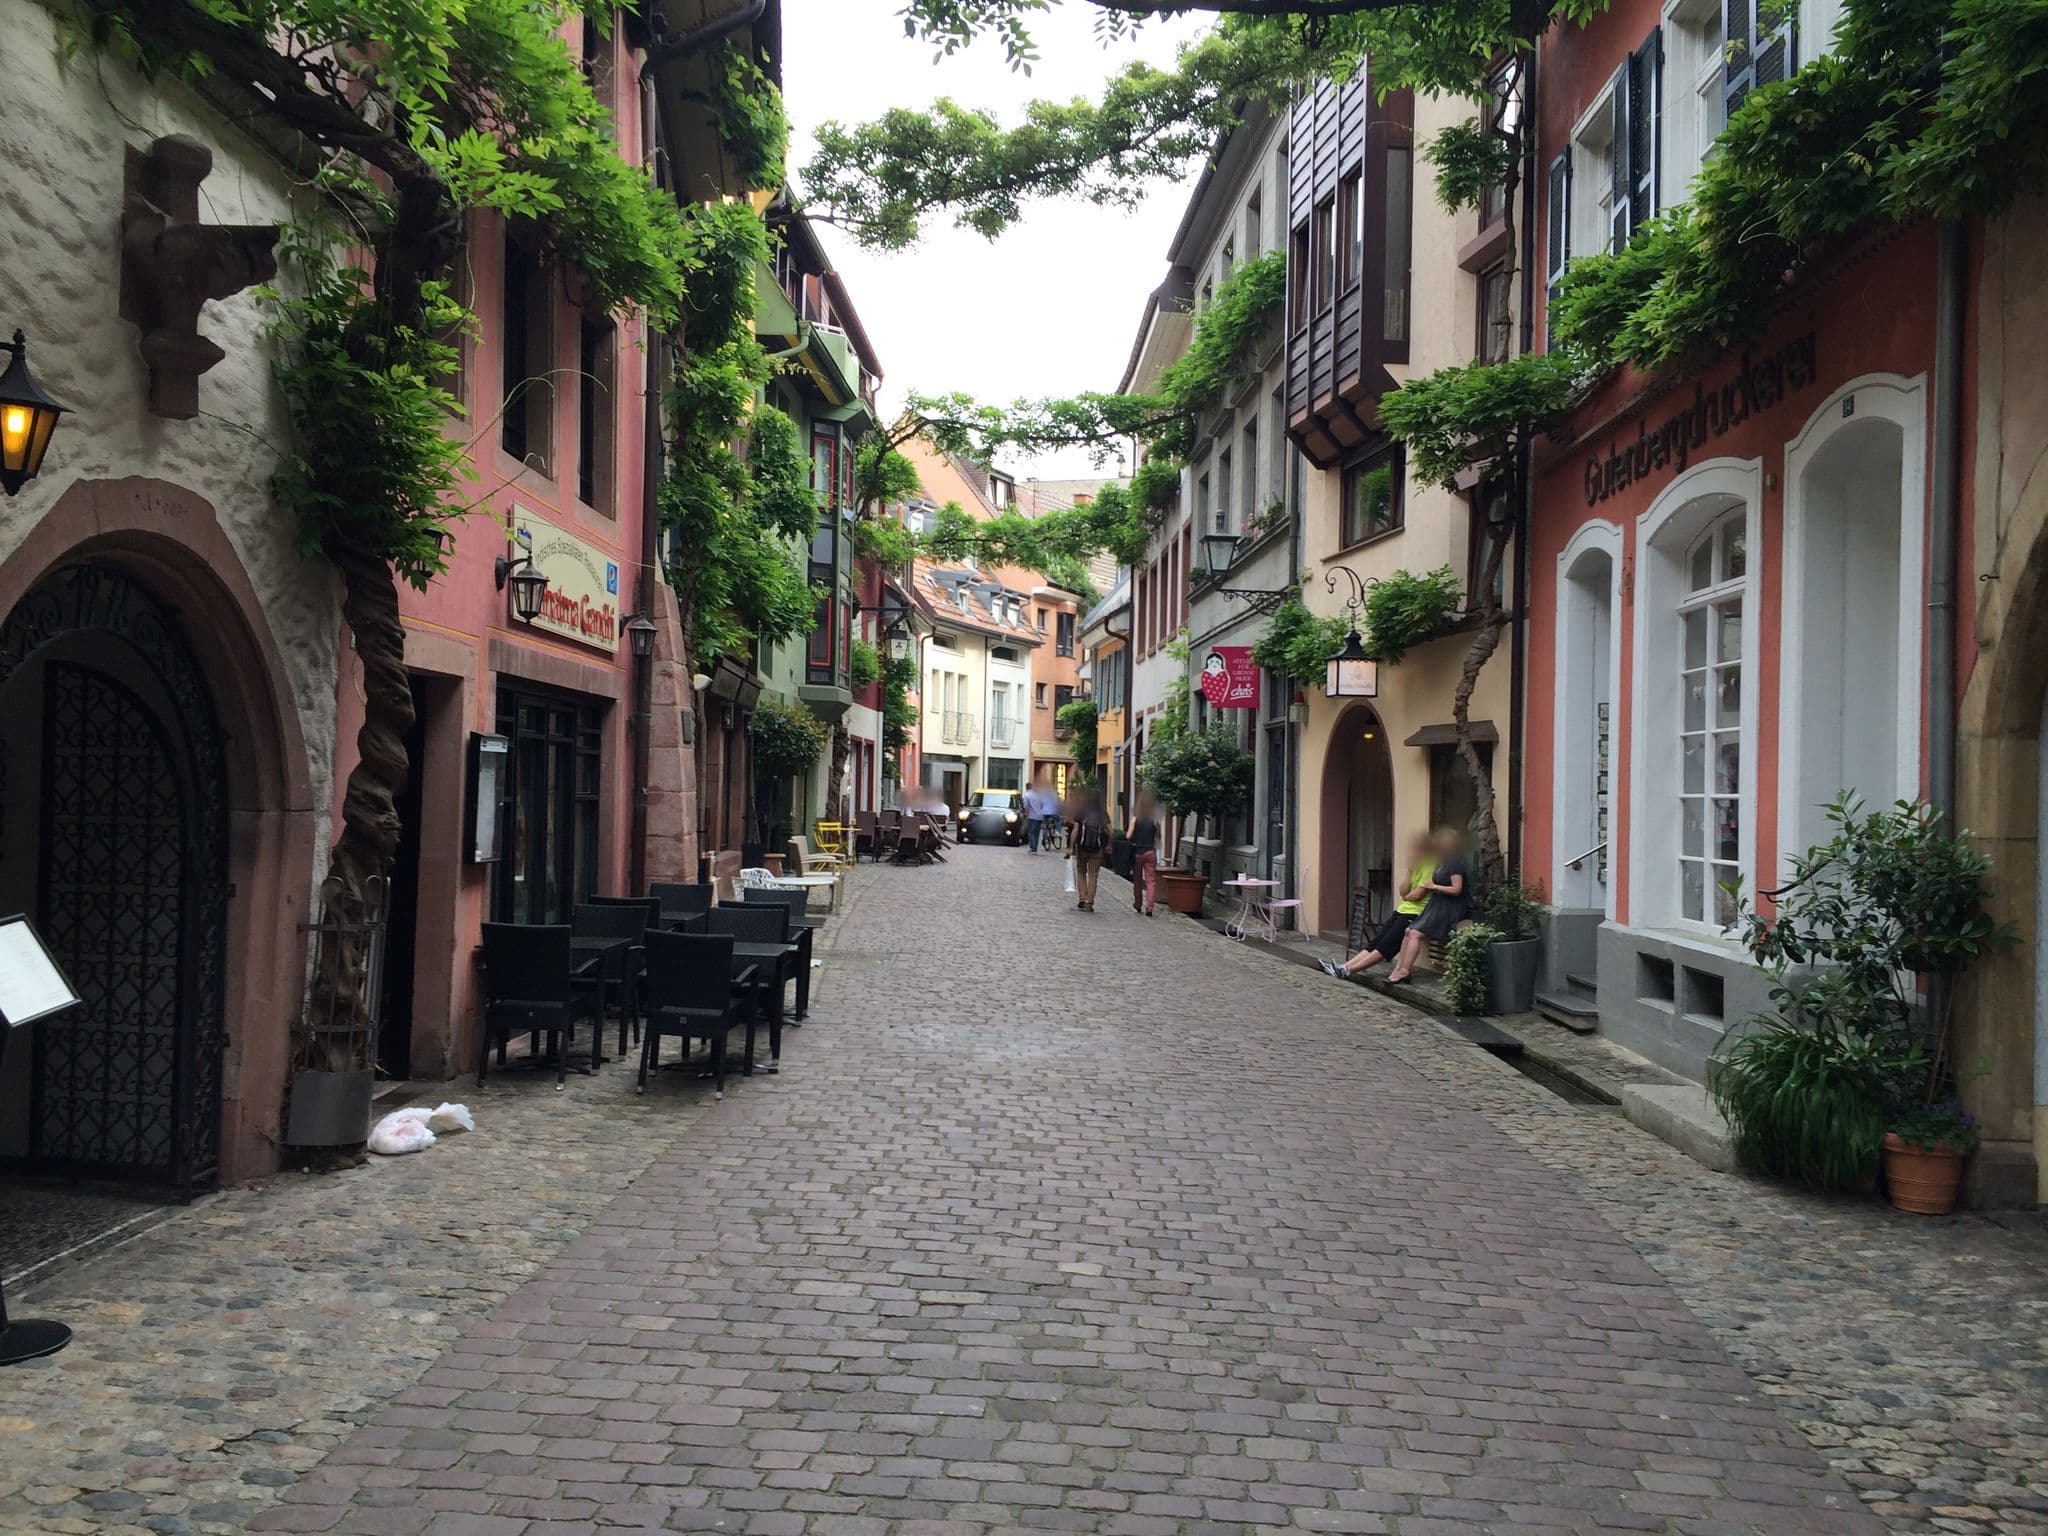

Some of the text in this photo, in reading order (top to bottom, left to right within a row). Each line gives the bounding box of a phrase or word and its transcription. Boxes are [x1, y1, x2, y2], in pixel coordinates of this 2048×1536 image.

[1584, 310, 1816, 507] Gutenbergdruckerei
[580, 594, 615, 641] Gandhi
[1230, 683, 1254, 697] chris
